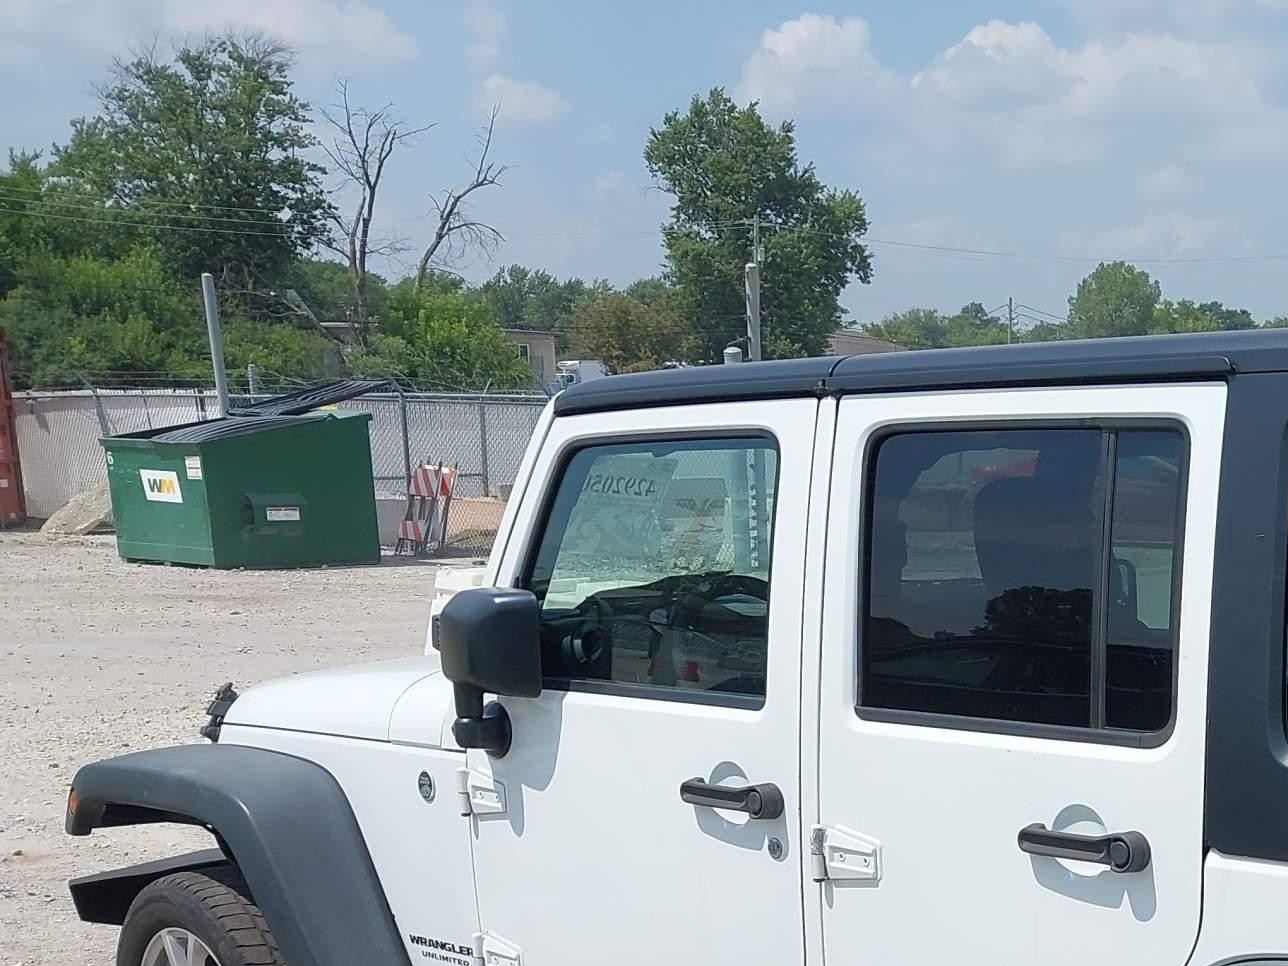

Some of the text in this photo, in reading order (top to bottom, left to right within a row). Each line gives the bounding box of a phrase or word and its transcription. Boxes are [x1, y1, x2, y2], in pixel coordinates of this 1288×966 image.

[147, 478, 175, 494] WM
[409, 934, 473, 956] WRANGLER
[422, 950, 470, 966] UNLIMITED
